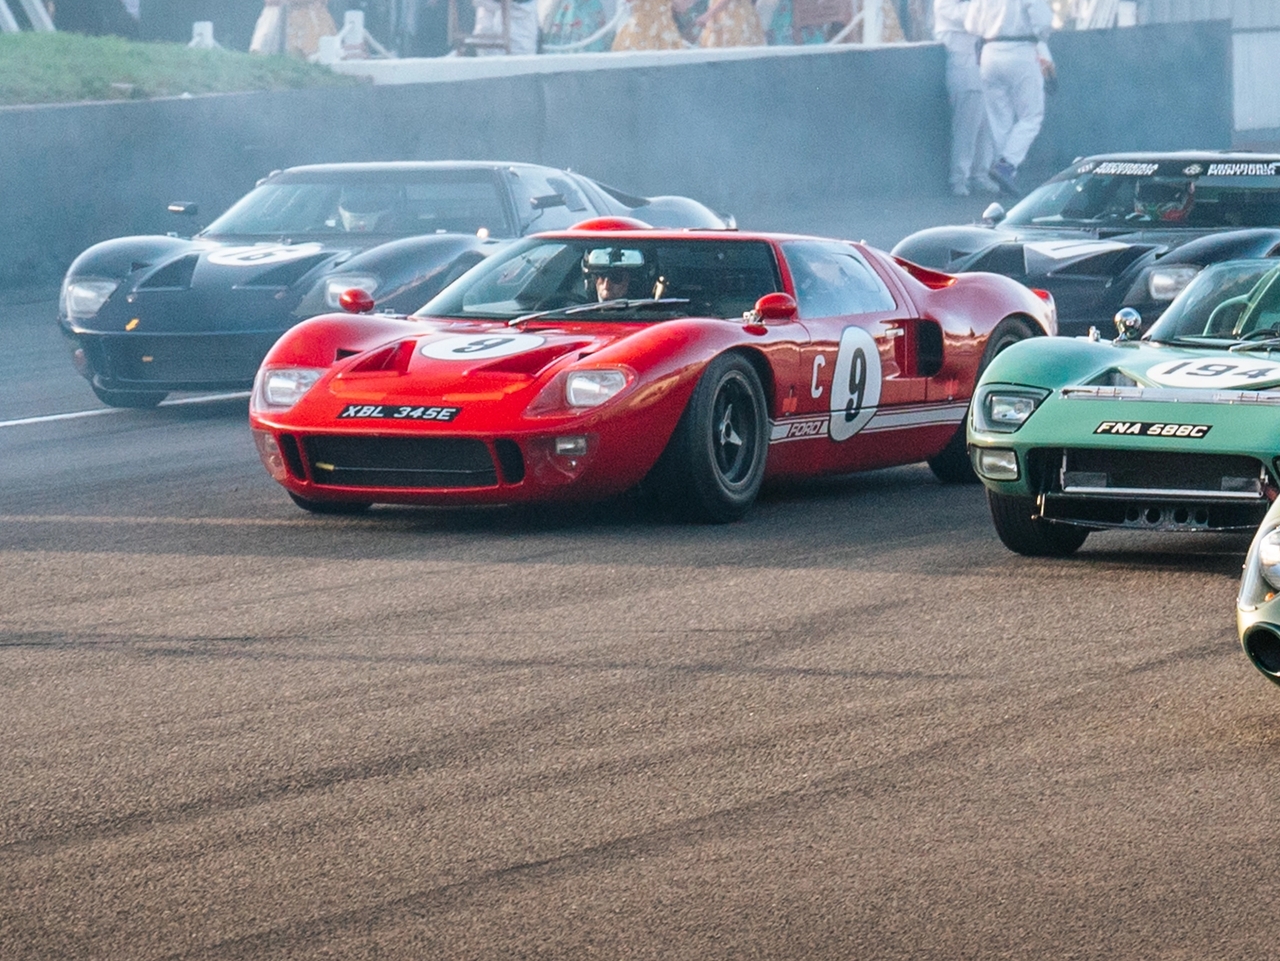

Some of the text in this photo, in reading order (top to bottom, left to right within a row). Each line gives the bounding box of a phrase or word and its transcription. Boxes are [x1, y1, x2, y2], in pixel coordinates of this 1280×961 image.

[1099, 161, 1159, 170] ESCUDERIA
[451, 337, 516, 354] 9
[1161, 360, 1278, 379] 194
[811, 346, 867, 423] C 9
[342, 405, 457, 420] XBL 345E
[788, 420, 821, 437] FORD
[1096, 422, 1209, 438] FNA 588C
